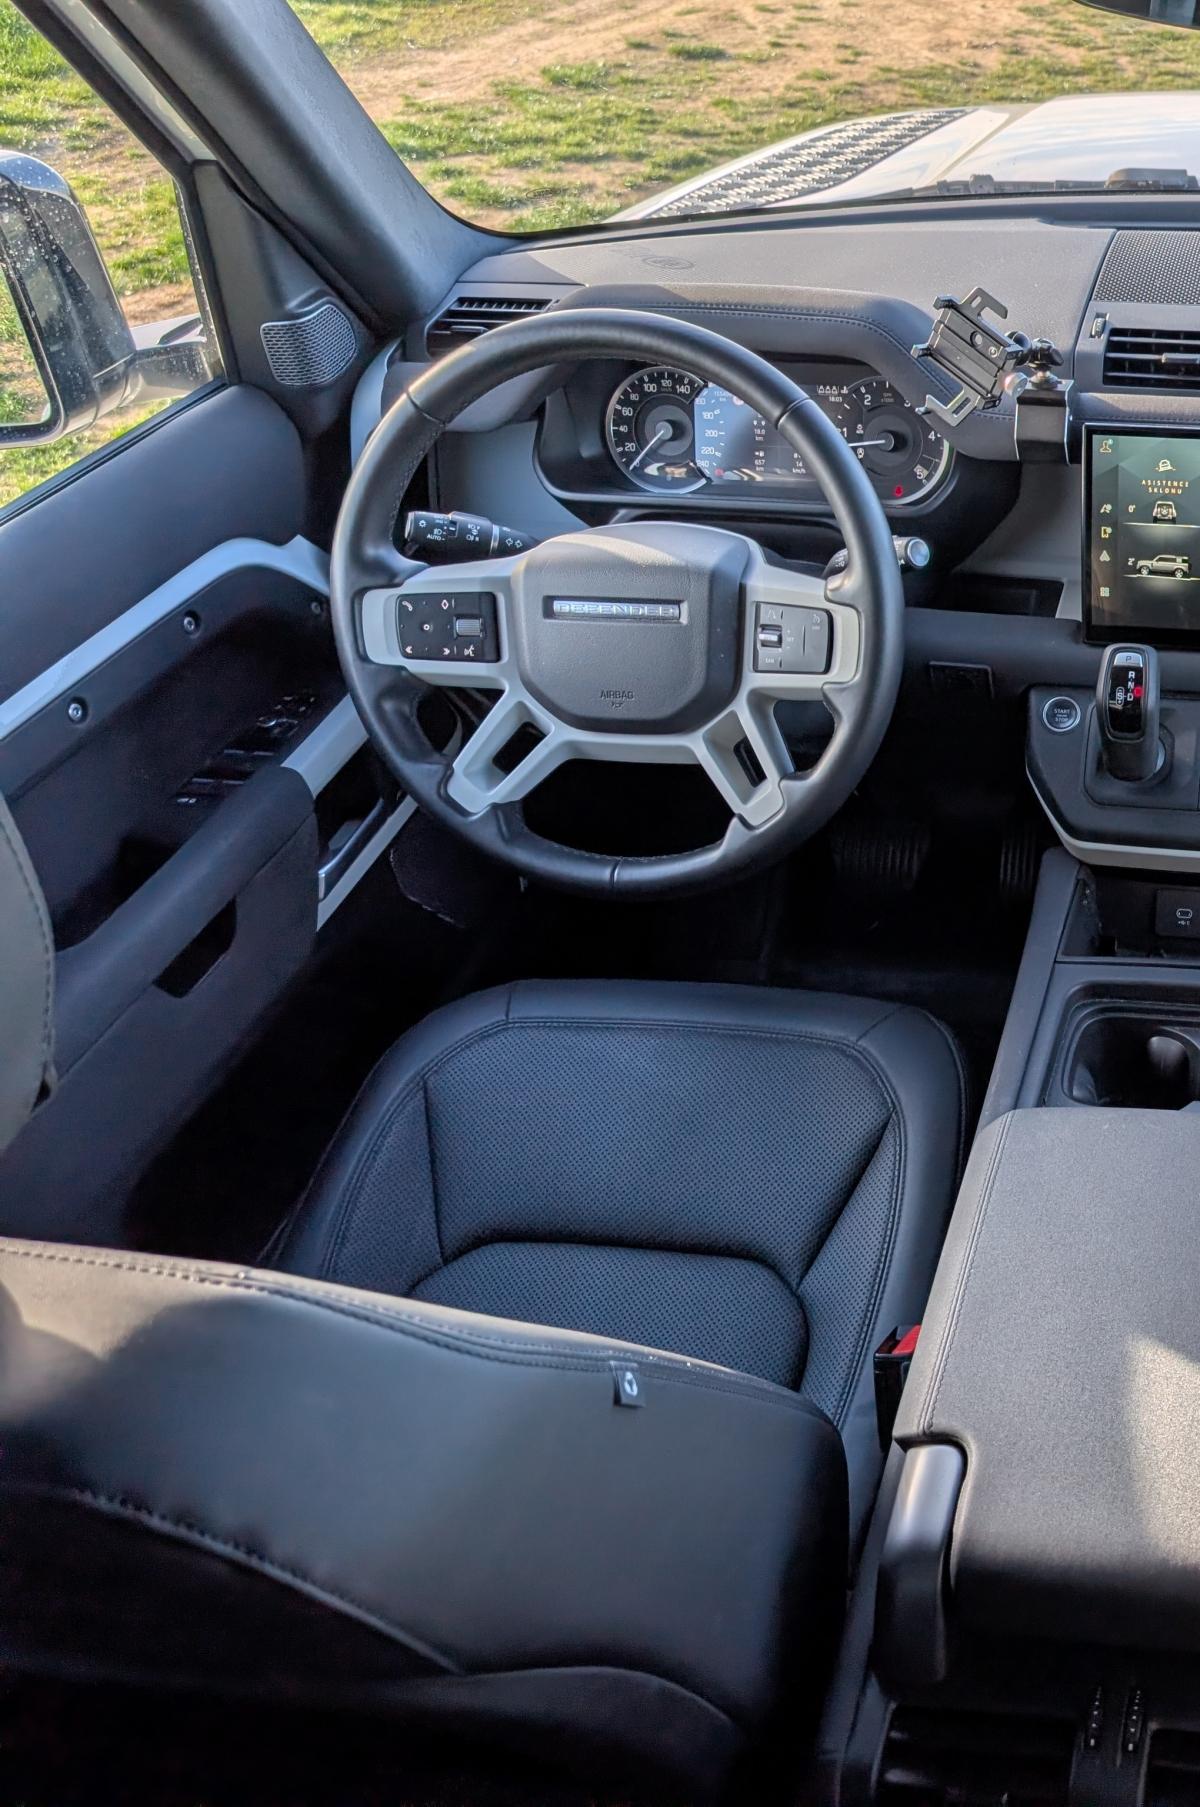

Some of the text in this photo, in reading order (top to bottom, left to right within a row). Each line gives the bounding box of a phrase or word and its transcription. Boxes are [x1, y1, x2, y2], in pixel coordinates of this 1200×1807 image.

[661, 379, 672, 387] 120
[643, 384, 657, 392] 100
[676, 385, 690, 394] 140
[630, 393, 639, 401] 80
[864, 395, 871, 405] 2
[622, 408, 633, 416] 60
[929, 431, 935, 441] 4
[625, 443, 635, 451] 20
[701, 446, 714, 454] 220
[916, 468, 924, 479] 5
[1141, 480, 1189, 488] ASISTENCE
[557, 603, 676, 616] DEFENDER
[1128, 671, 1135, 679] R
[600, 690, 633, 700] AIRBAG
